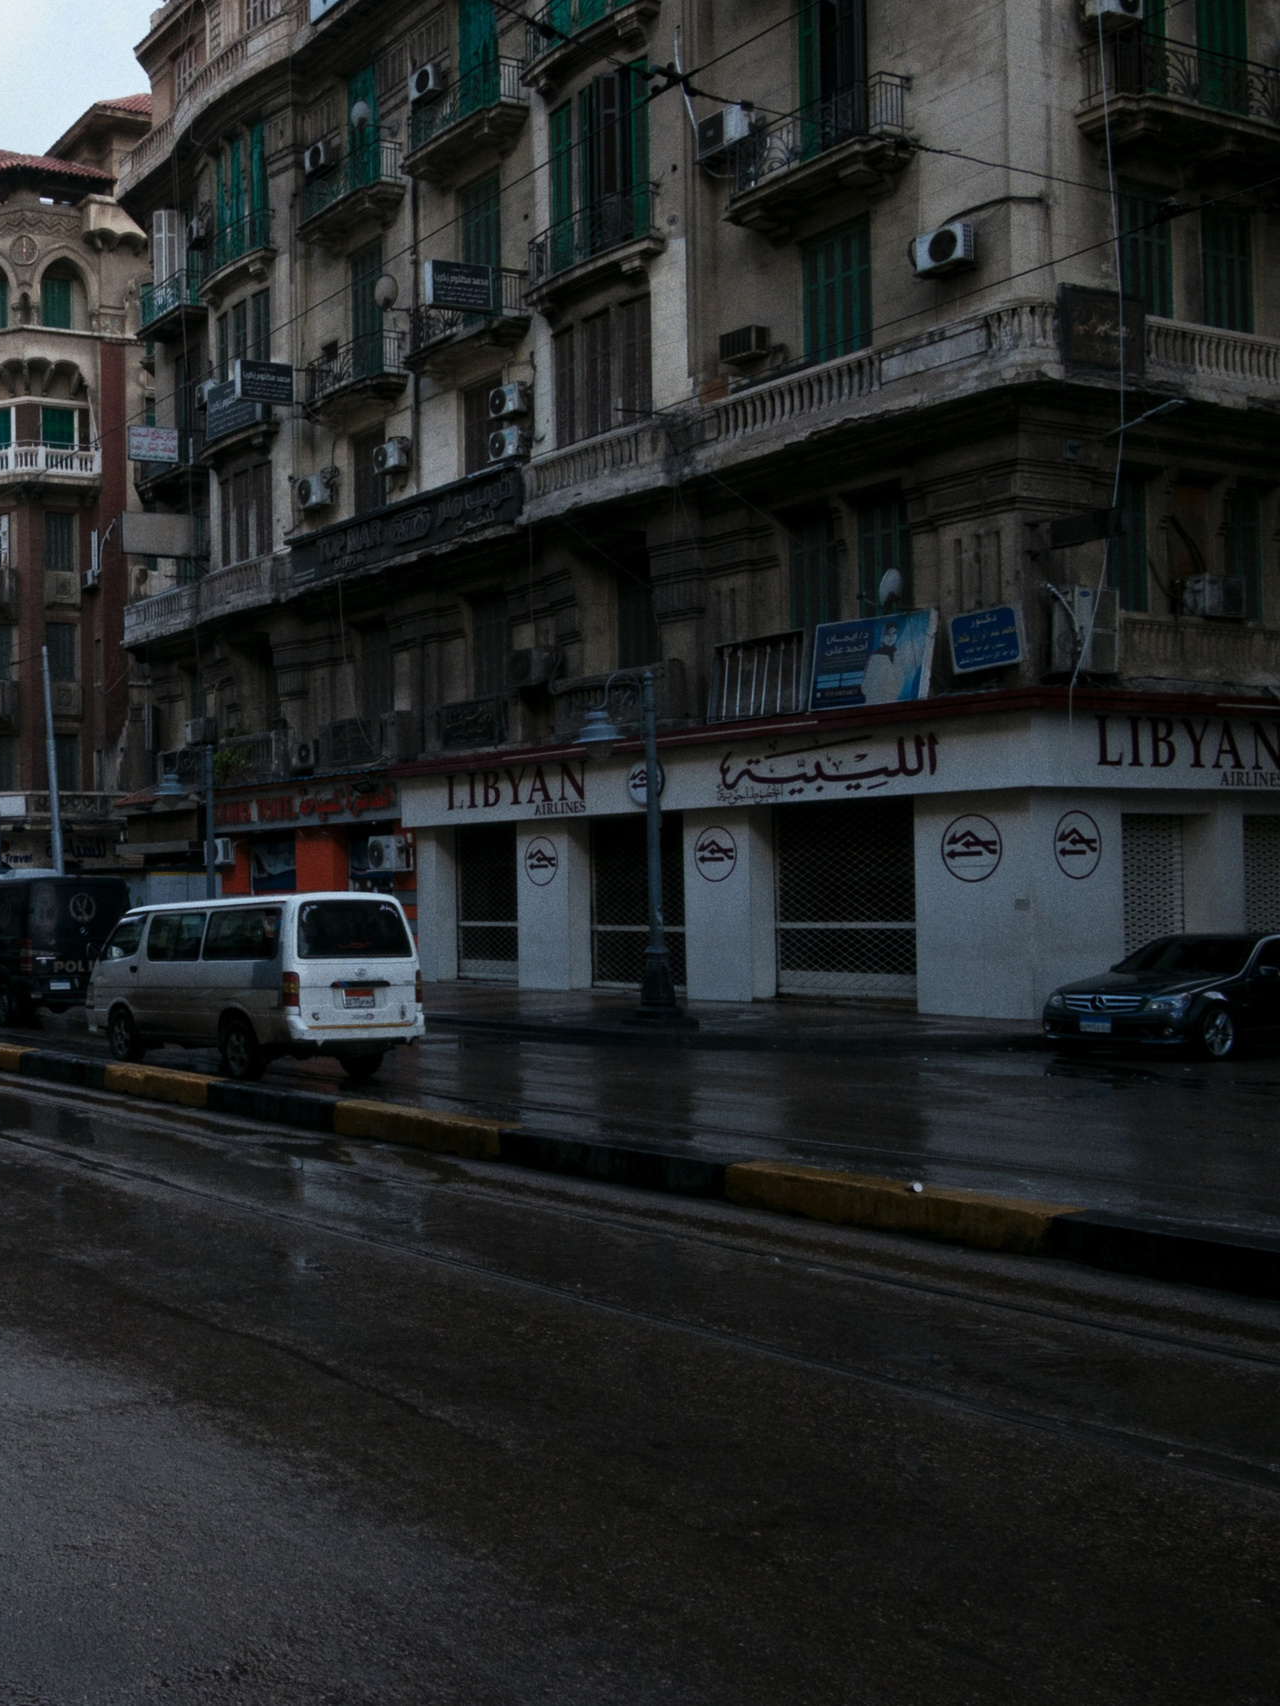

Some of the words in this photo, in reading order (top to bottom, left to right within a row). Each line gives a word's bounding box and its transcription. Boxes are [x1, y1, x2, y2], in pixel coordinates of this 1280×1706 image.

[316, 530, 345, 562] TOP
[347, 519, 381, 554] MAR
[970, 612, 997, 629] دكتور
[1094, 714, 1280, 769] LIBYAN
[446, 760, 588, 811] LIBYAN
[534, 800, 587, 816] AIRLINES
[5, 853, 33, 864] Travel
[52, 959, 94, 974] POLI
